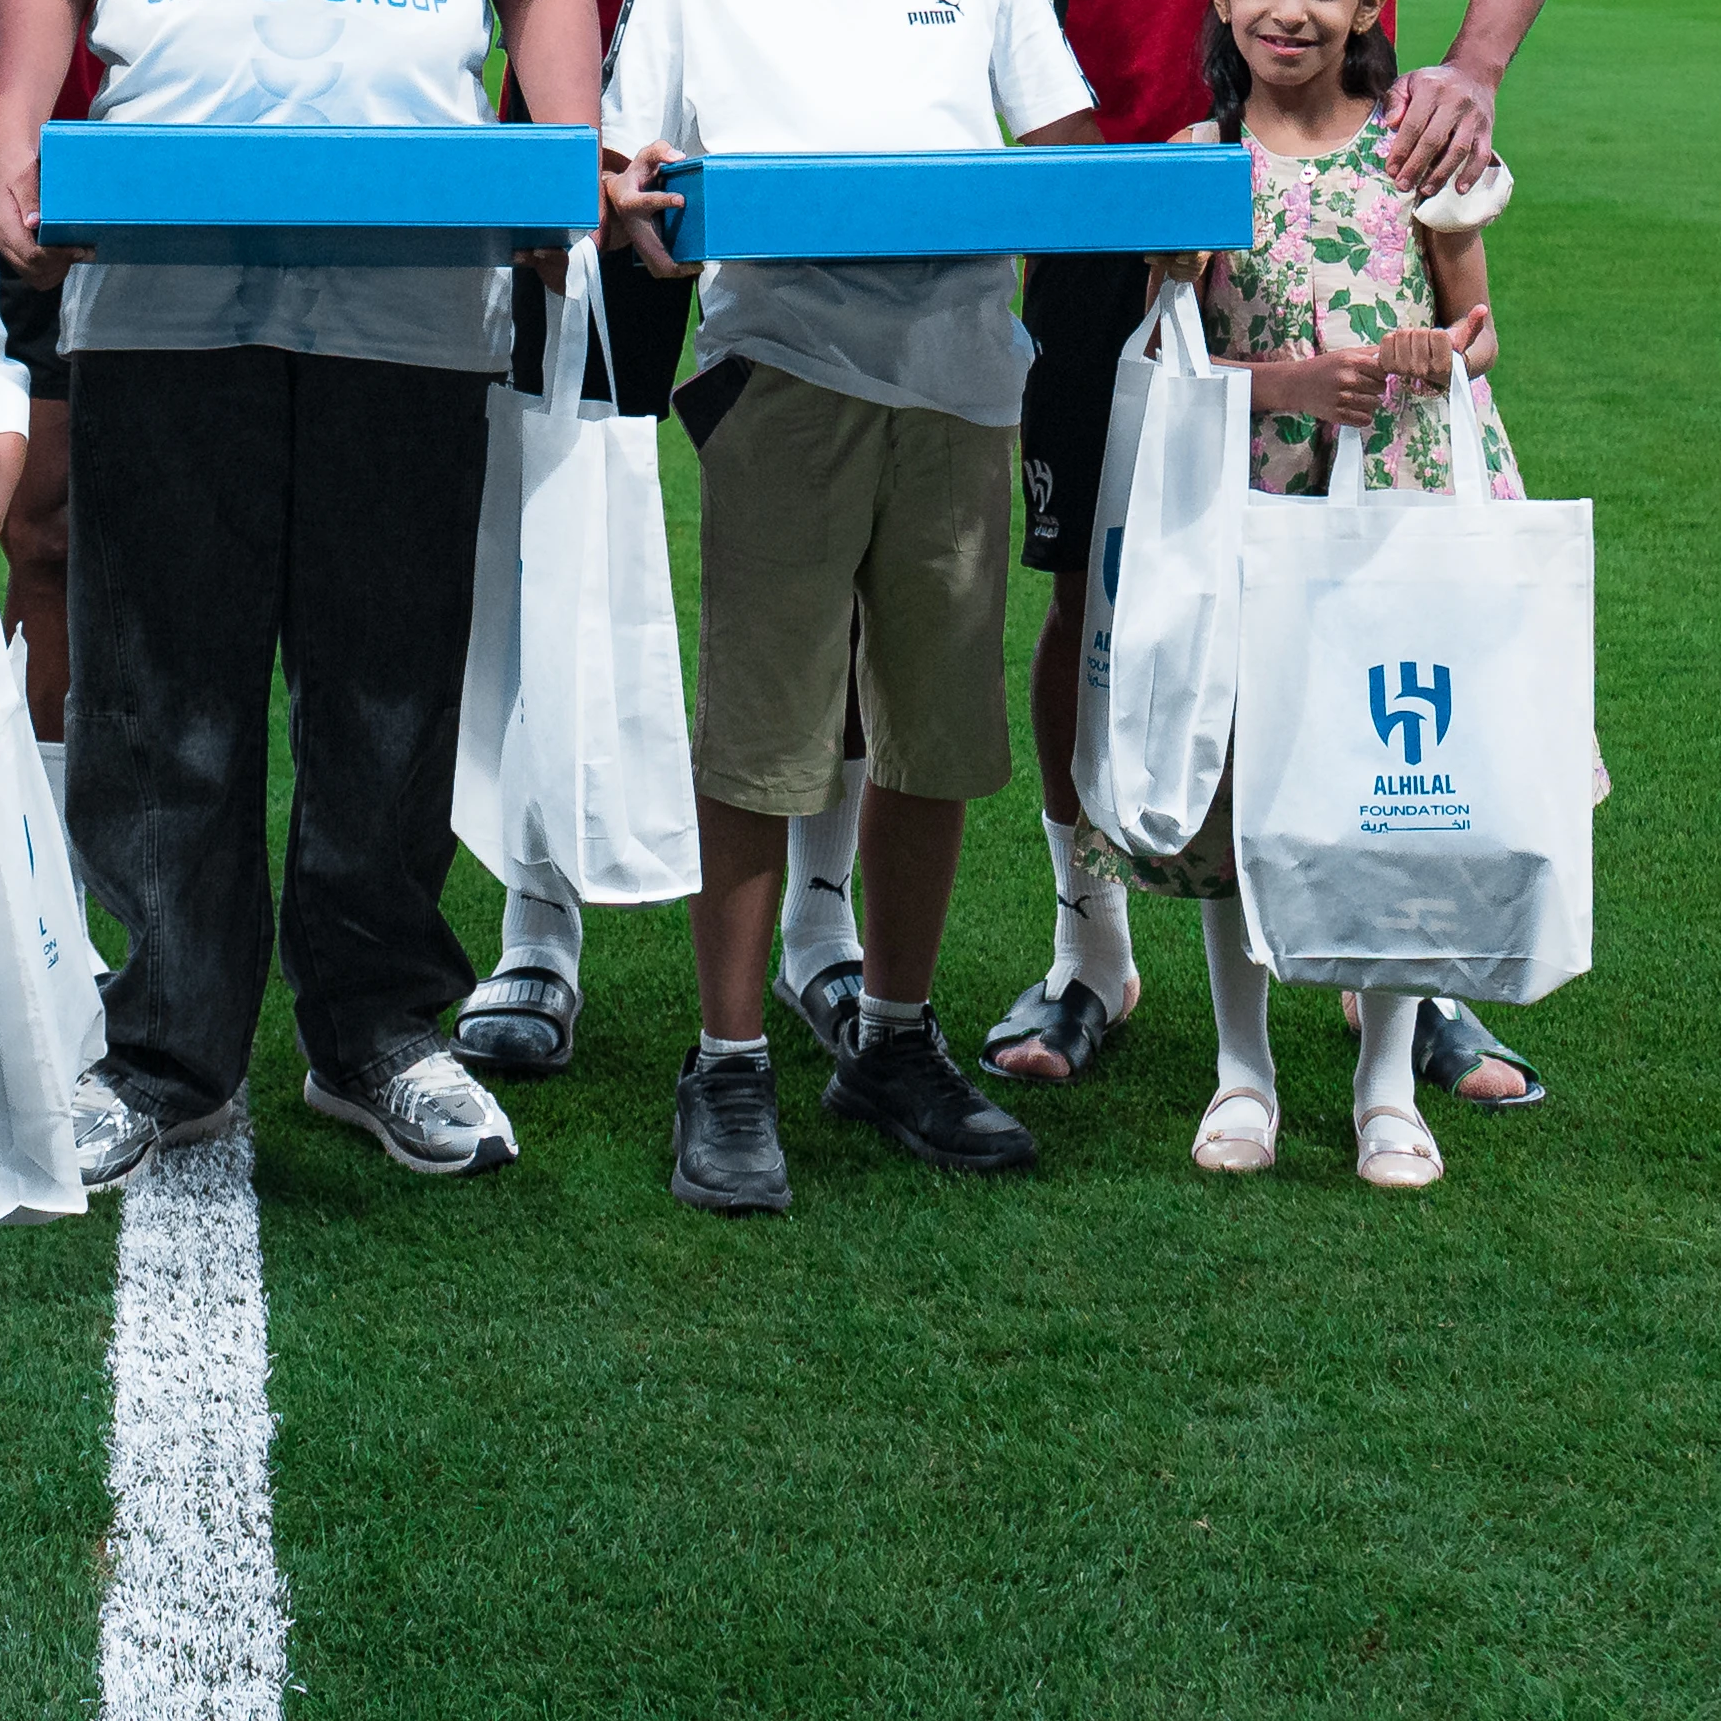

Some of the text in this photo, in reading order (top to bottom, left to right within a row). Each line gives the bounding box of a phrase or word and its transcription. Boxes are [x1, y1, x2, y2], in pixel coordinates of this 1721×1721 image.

[907, 10, 956, 25] PUMA
[1373, 774, 1457, 796] ALHILAL
[1359, 804, 1470, 817] FOUNDATION
